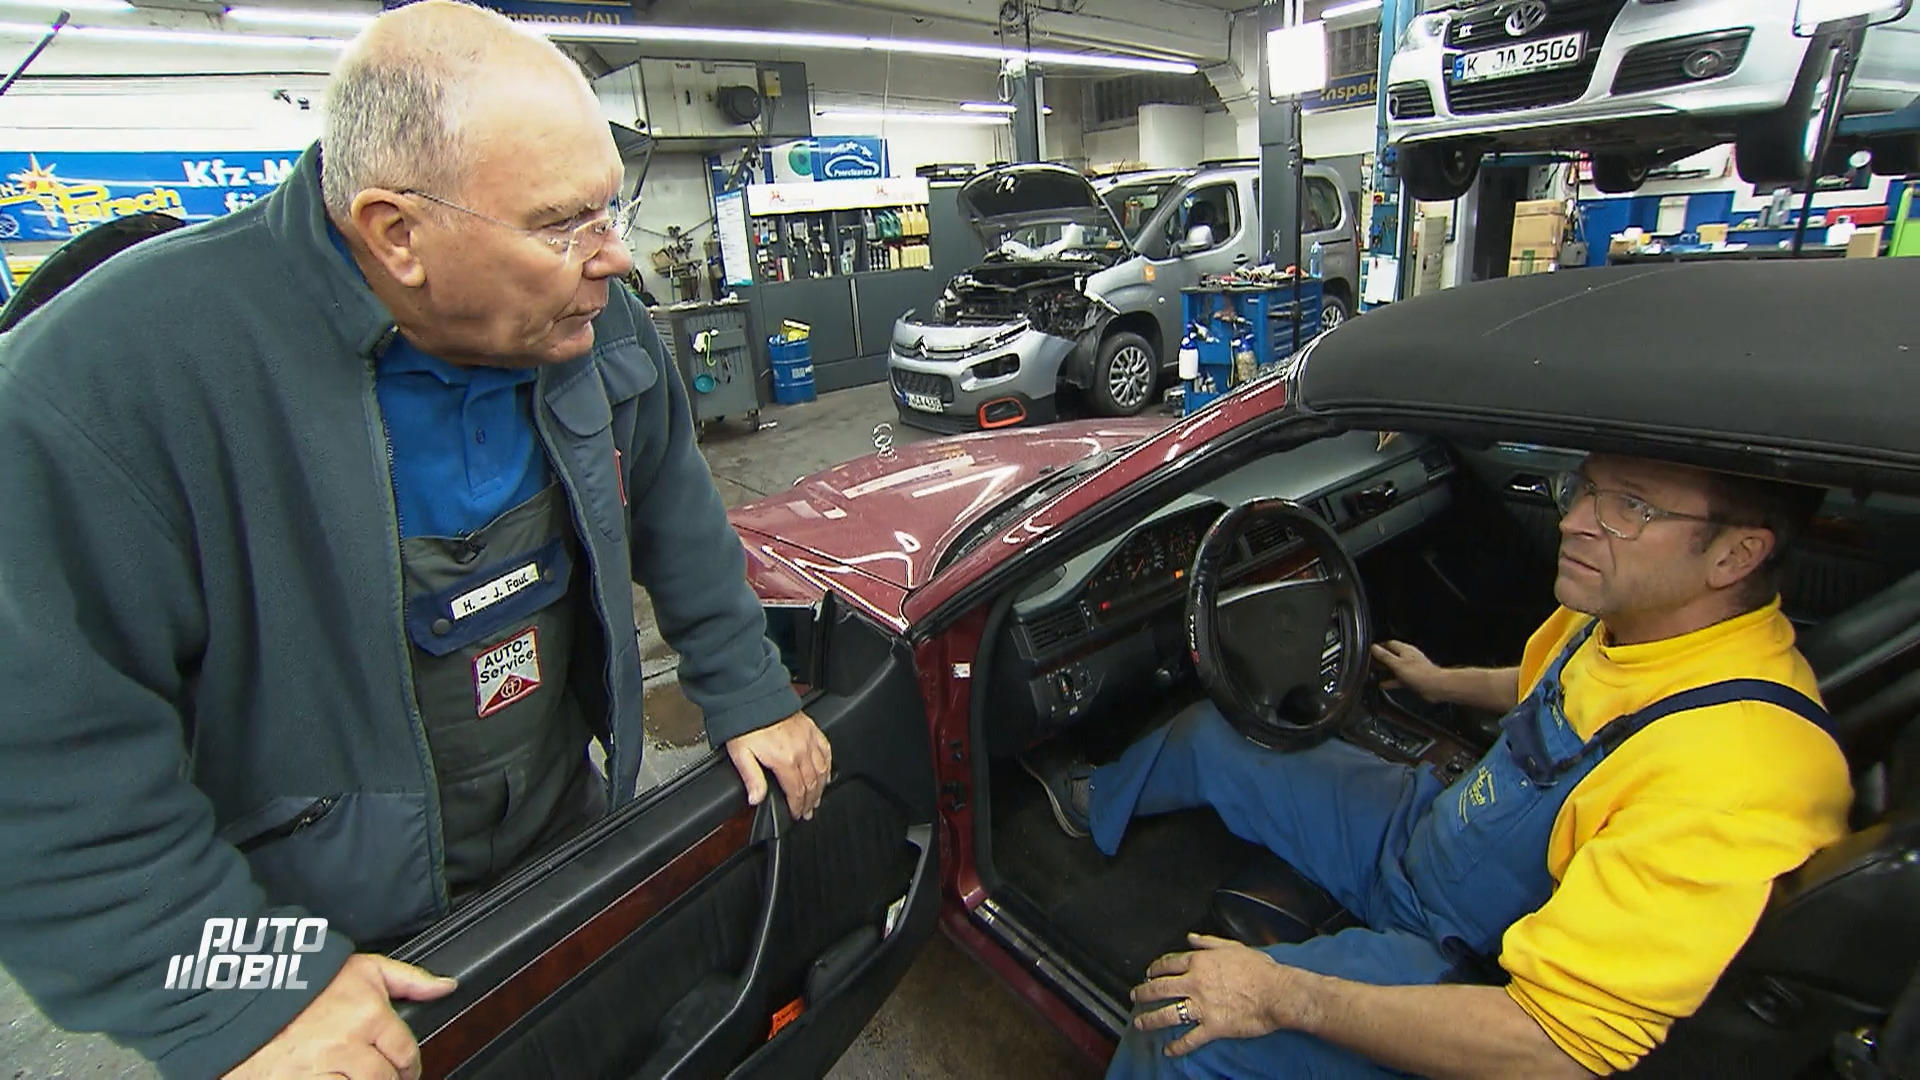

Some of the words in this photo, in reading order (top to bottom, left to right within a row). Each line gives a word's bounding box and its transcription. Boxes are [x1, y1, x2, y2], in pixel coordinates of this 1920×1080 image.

[1467, 57, 1478, 71] K
[1522, 37, 1577, 66] 2506
[463, 599, 476, 612] H.
[493, 587, 503, 598] J.
[480, 650, 534, 684] Service
[484, 640, 529, 669] AUTO-
